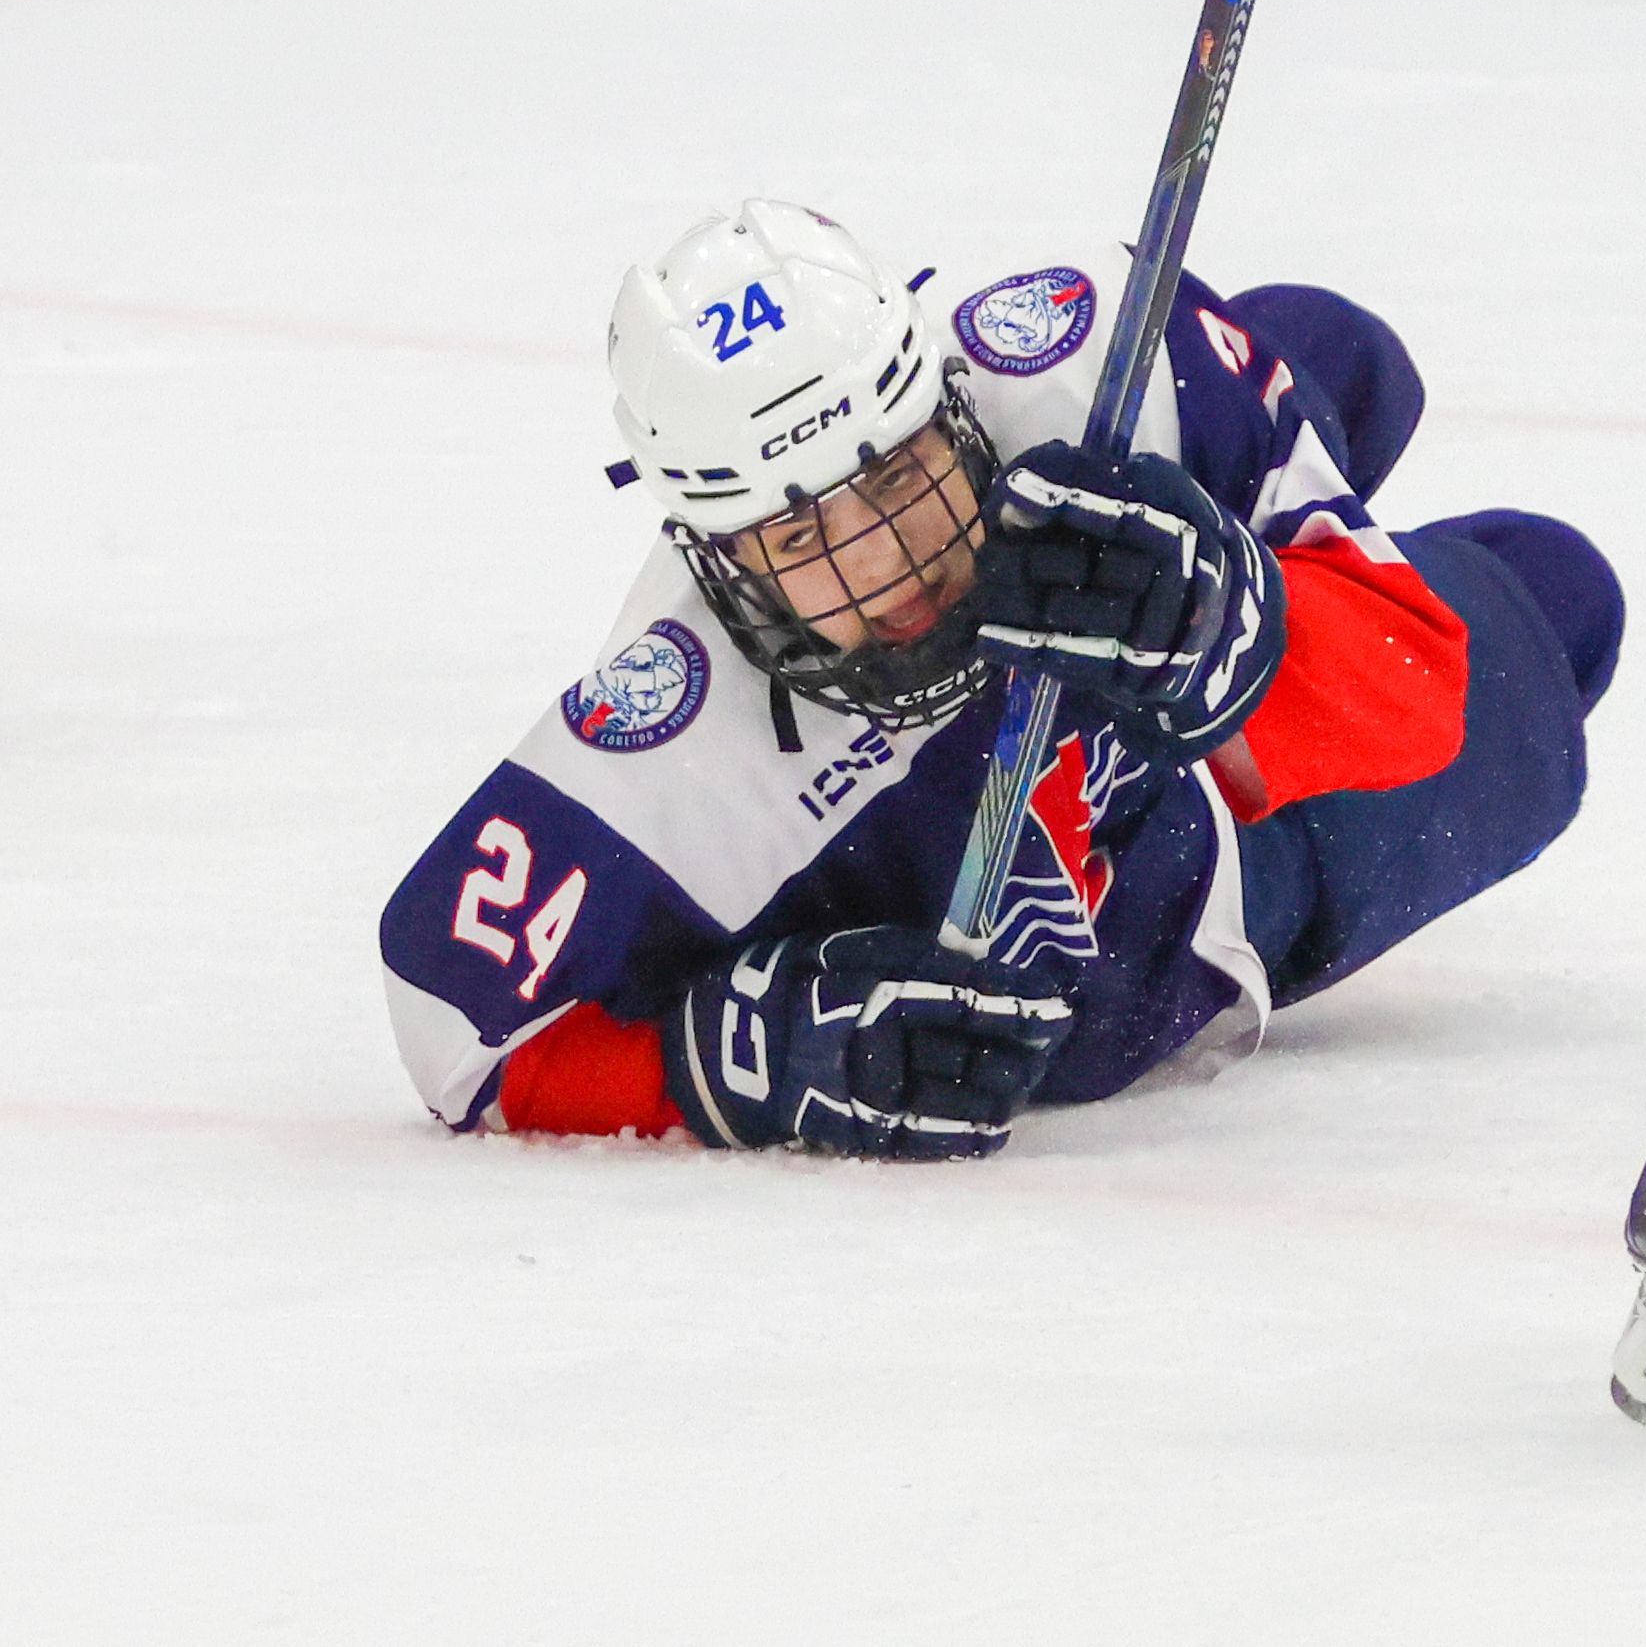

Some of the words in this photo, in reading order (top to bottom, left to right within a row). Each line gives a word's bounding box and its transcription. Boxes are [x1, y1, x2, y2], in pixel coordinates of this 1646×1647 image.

[697, 281, 787, 363] 24
[761, 396, 852, 461] CCM
[452, 816, 588, 1000] 24
